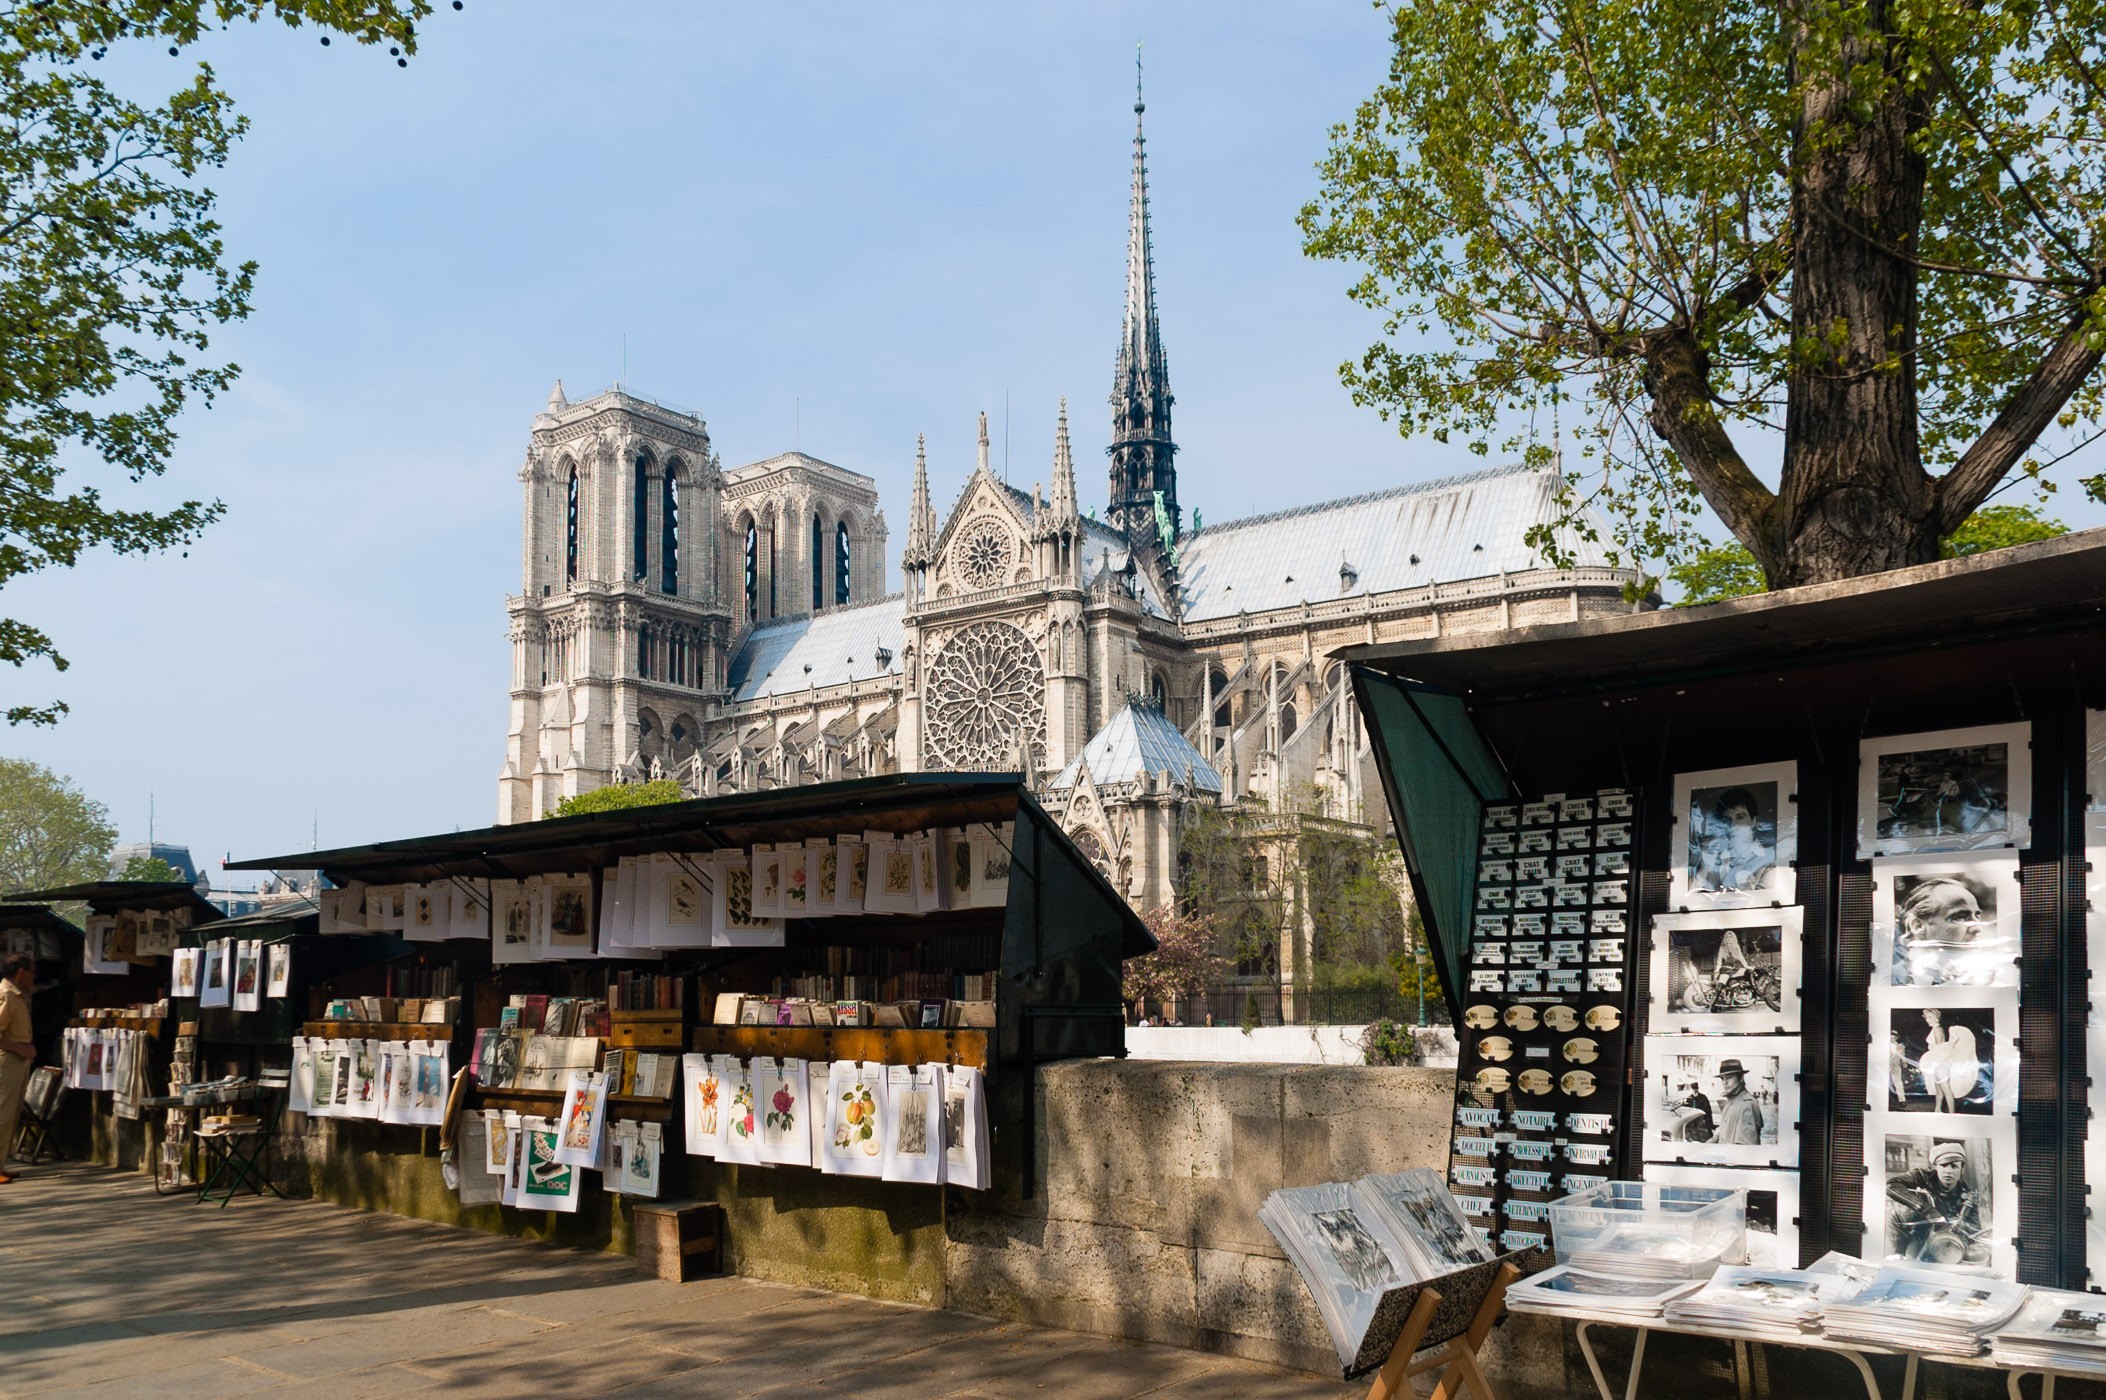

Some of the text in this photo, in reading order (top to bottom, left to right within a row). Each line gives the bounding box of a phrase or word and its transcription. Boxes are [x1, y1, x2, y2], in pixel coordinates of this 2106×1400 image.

[1464, 1112, 1496, 1124] AVOCAT
[1517, 1114, 1550, 1127] NOTAIRE
[1571, 1117, 1609, 1129] DENTISTE
[1461, 1140, 1492, 1153] DOCTEUR
[1514, 1144, 1550, 1157] PROFESSEUR
[1510, 1173, 1548, 1186] DIRECTEUR
[1461, 1200, 1483, 1212] CHEF
